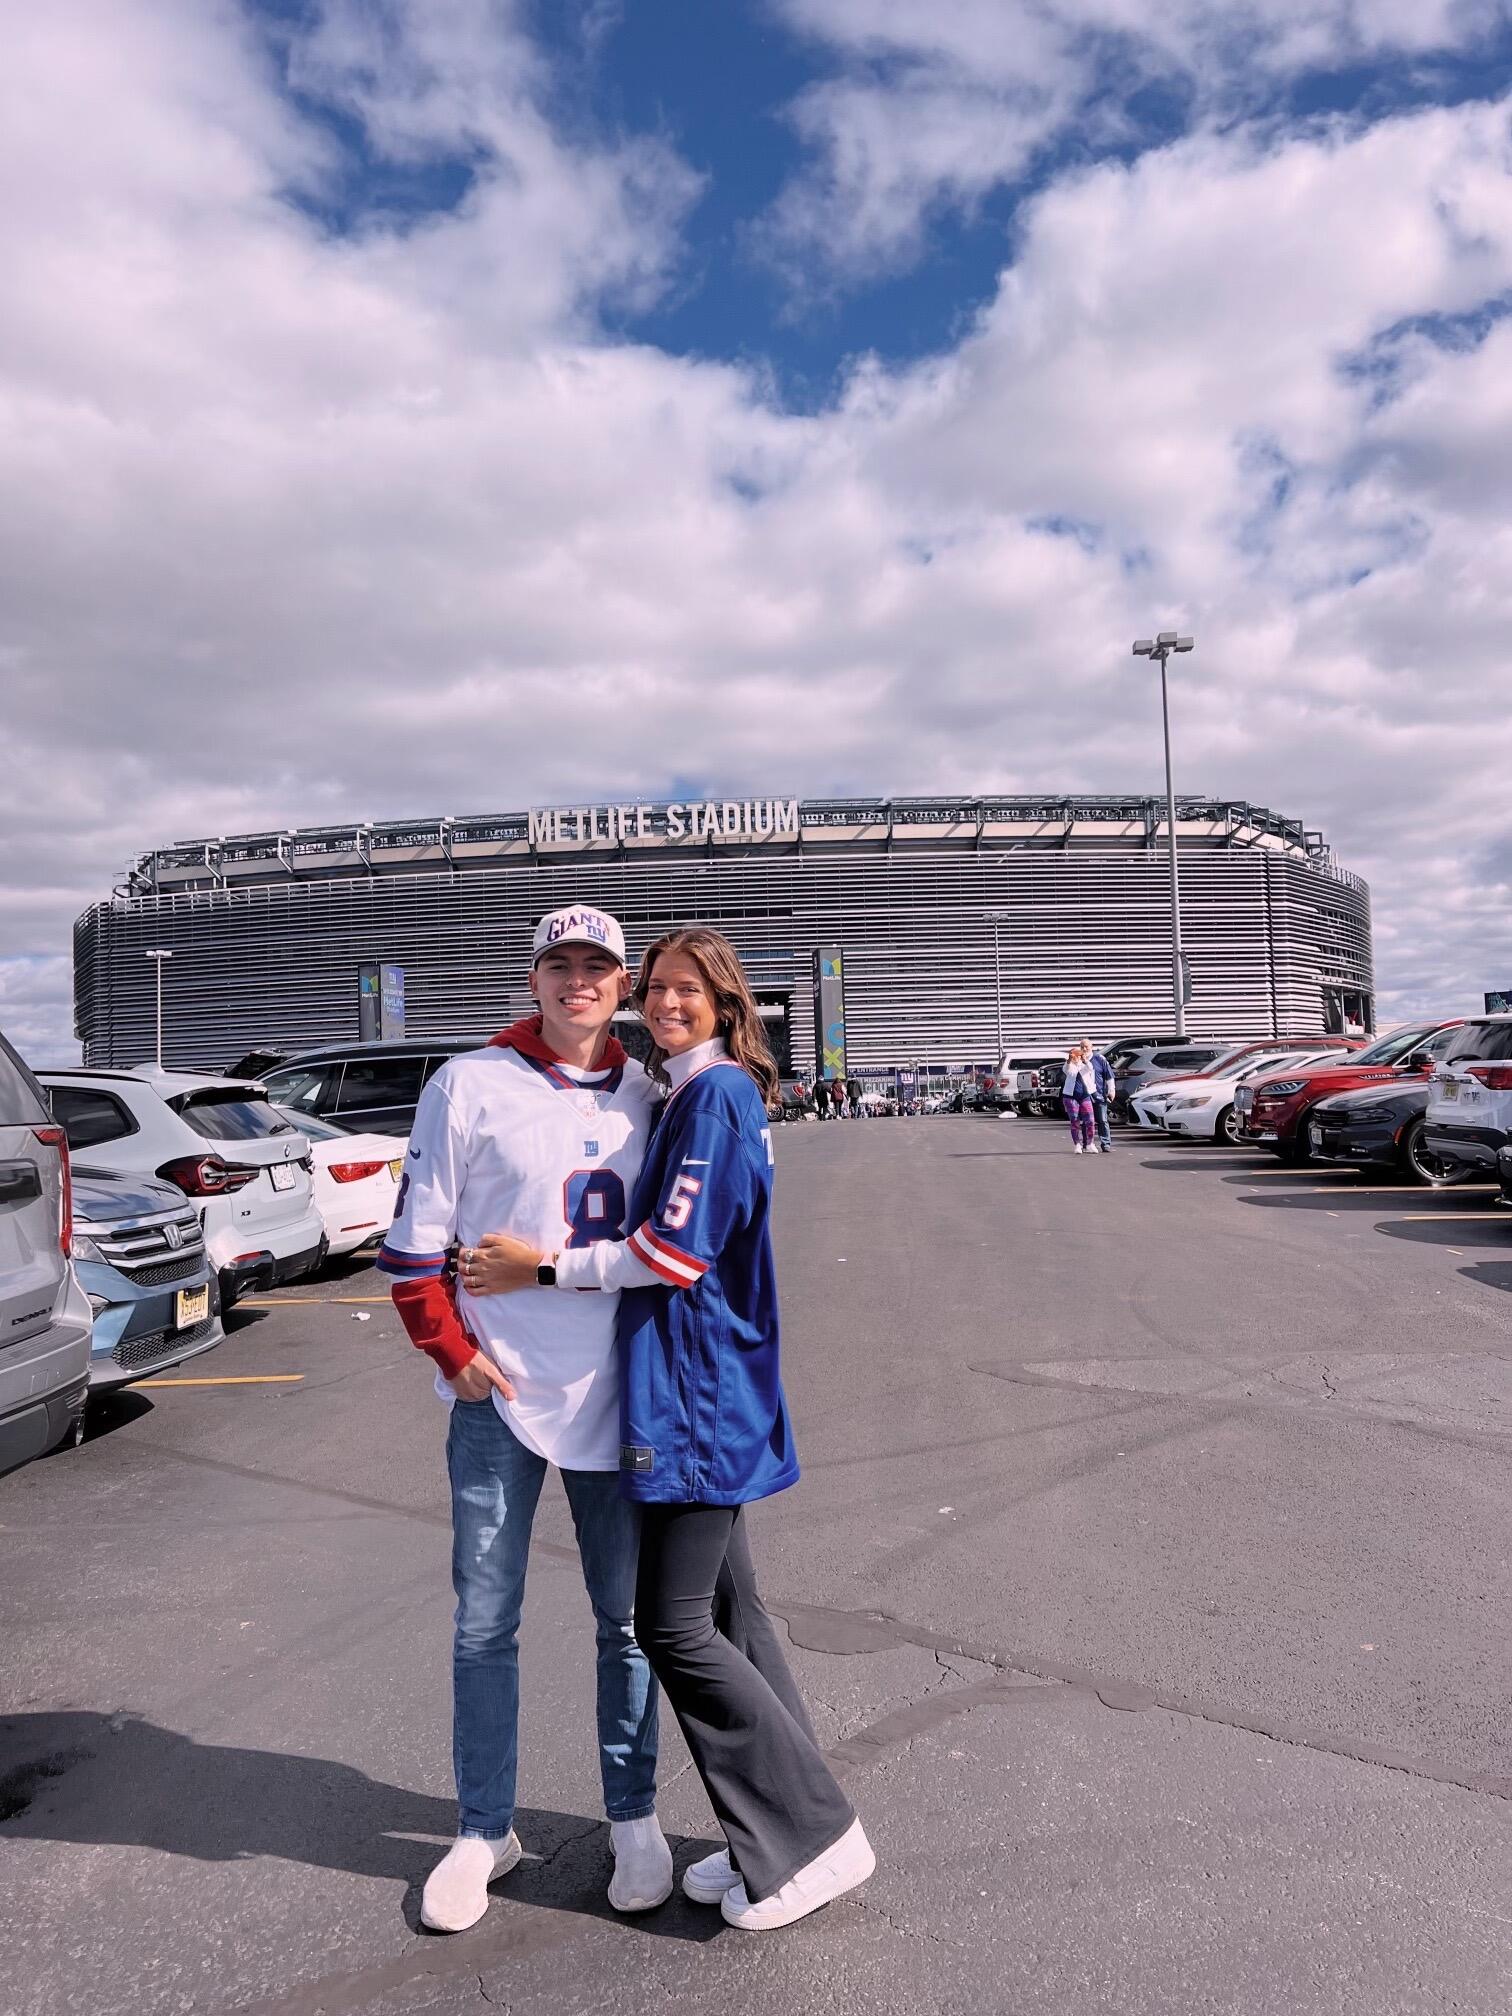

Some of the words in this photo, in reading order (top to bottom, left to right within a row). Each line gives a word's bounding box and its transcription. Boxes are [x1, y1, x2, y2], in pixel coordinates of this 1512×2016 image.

[528, 806, 654, 844] METLIFE
[667, 800, 799, 838] STADIUM
[563, 1168, 627, 1292] 8
[662, 1173, 703, 1231] 5
